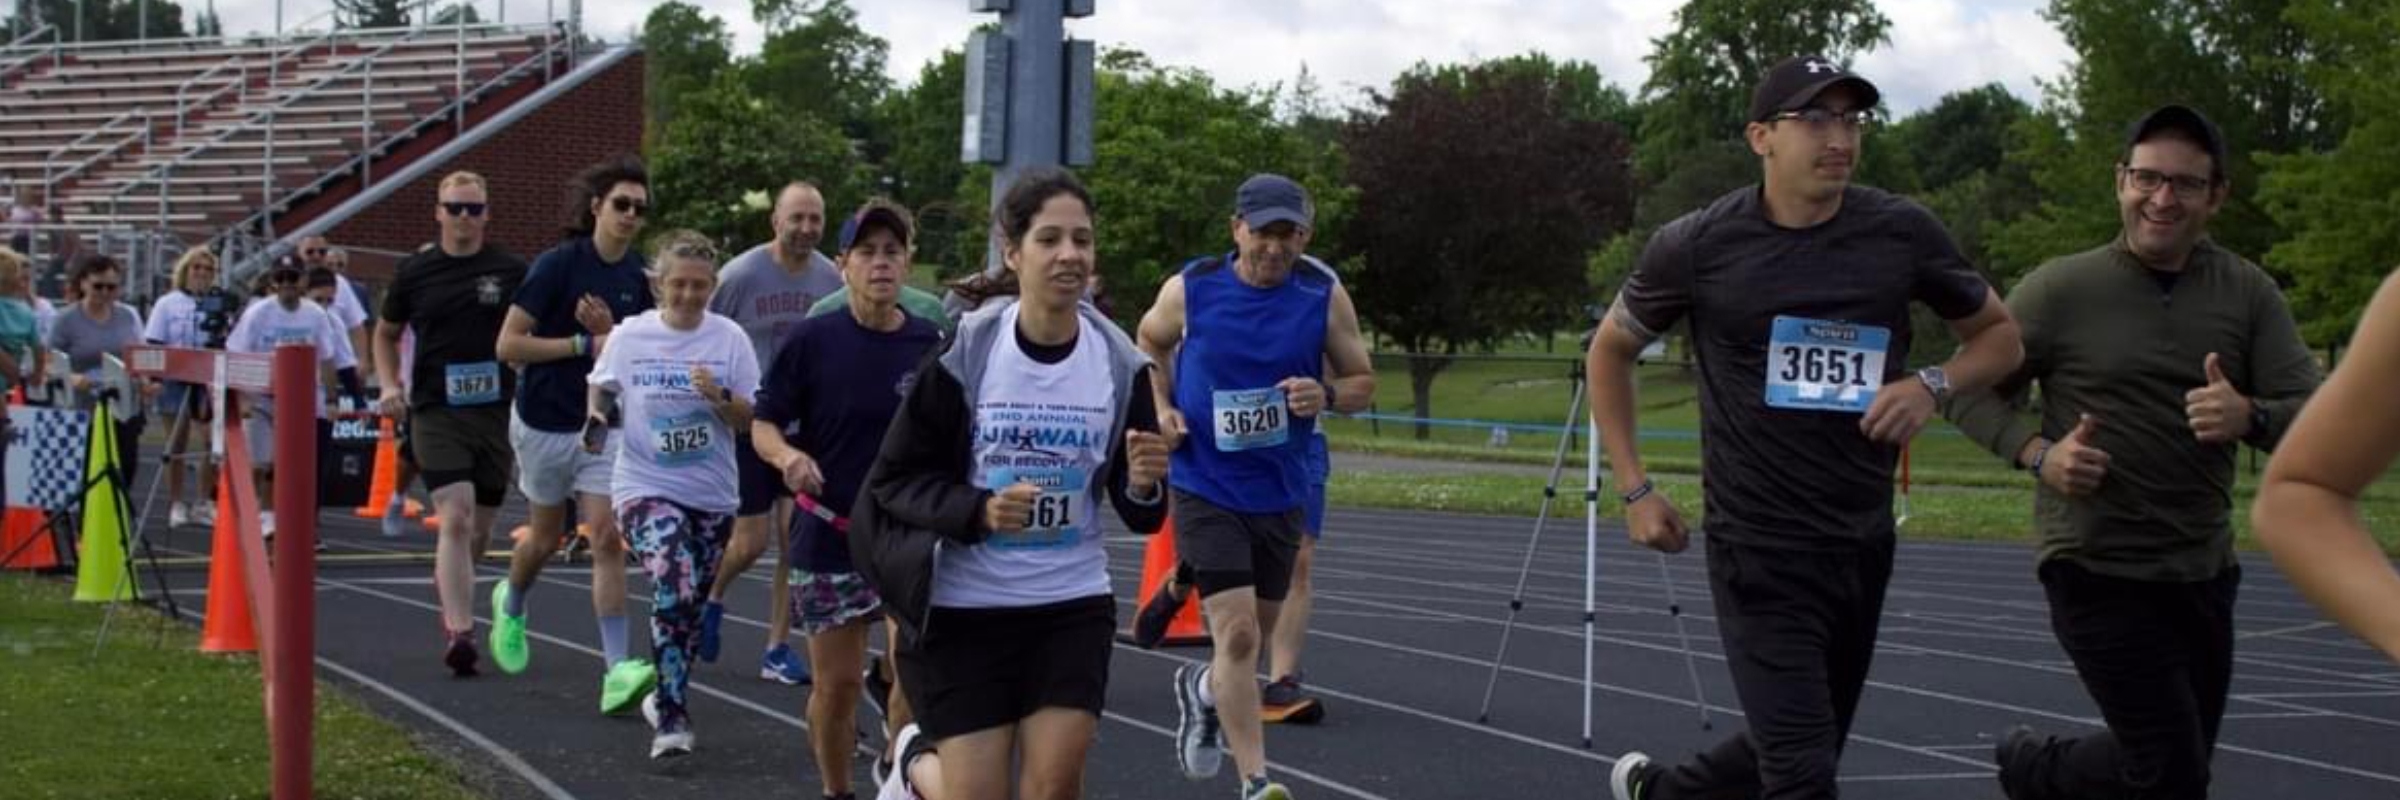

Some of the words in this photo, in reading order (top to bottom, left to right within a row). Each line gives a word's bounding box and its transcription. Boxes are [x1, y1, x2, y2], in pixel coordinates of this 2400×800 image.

[1780, 346, 1868, 387] 3651
[1026, 412, 1087, 424] ANNUAL
[1222, 404, 1279, 435] 3620
[660, 426, 709, 453] 3625
[983, 454, 1011, 466] FOR
